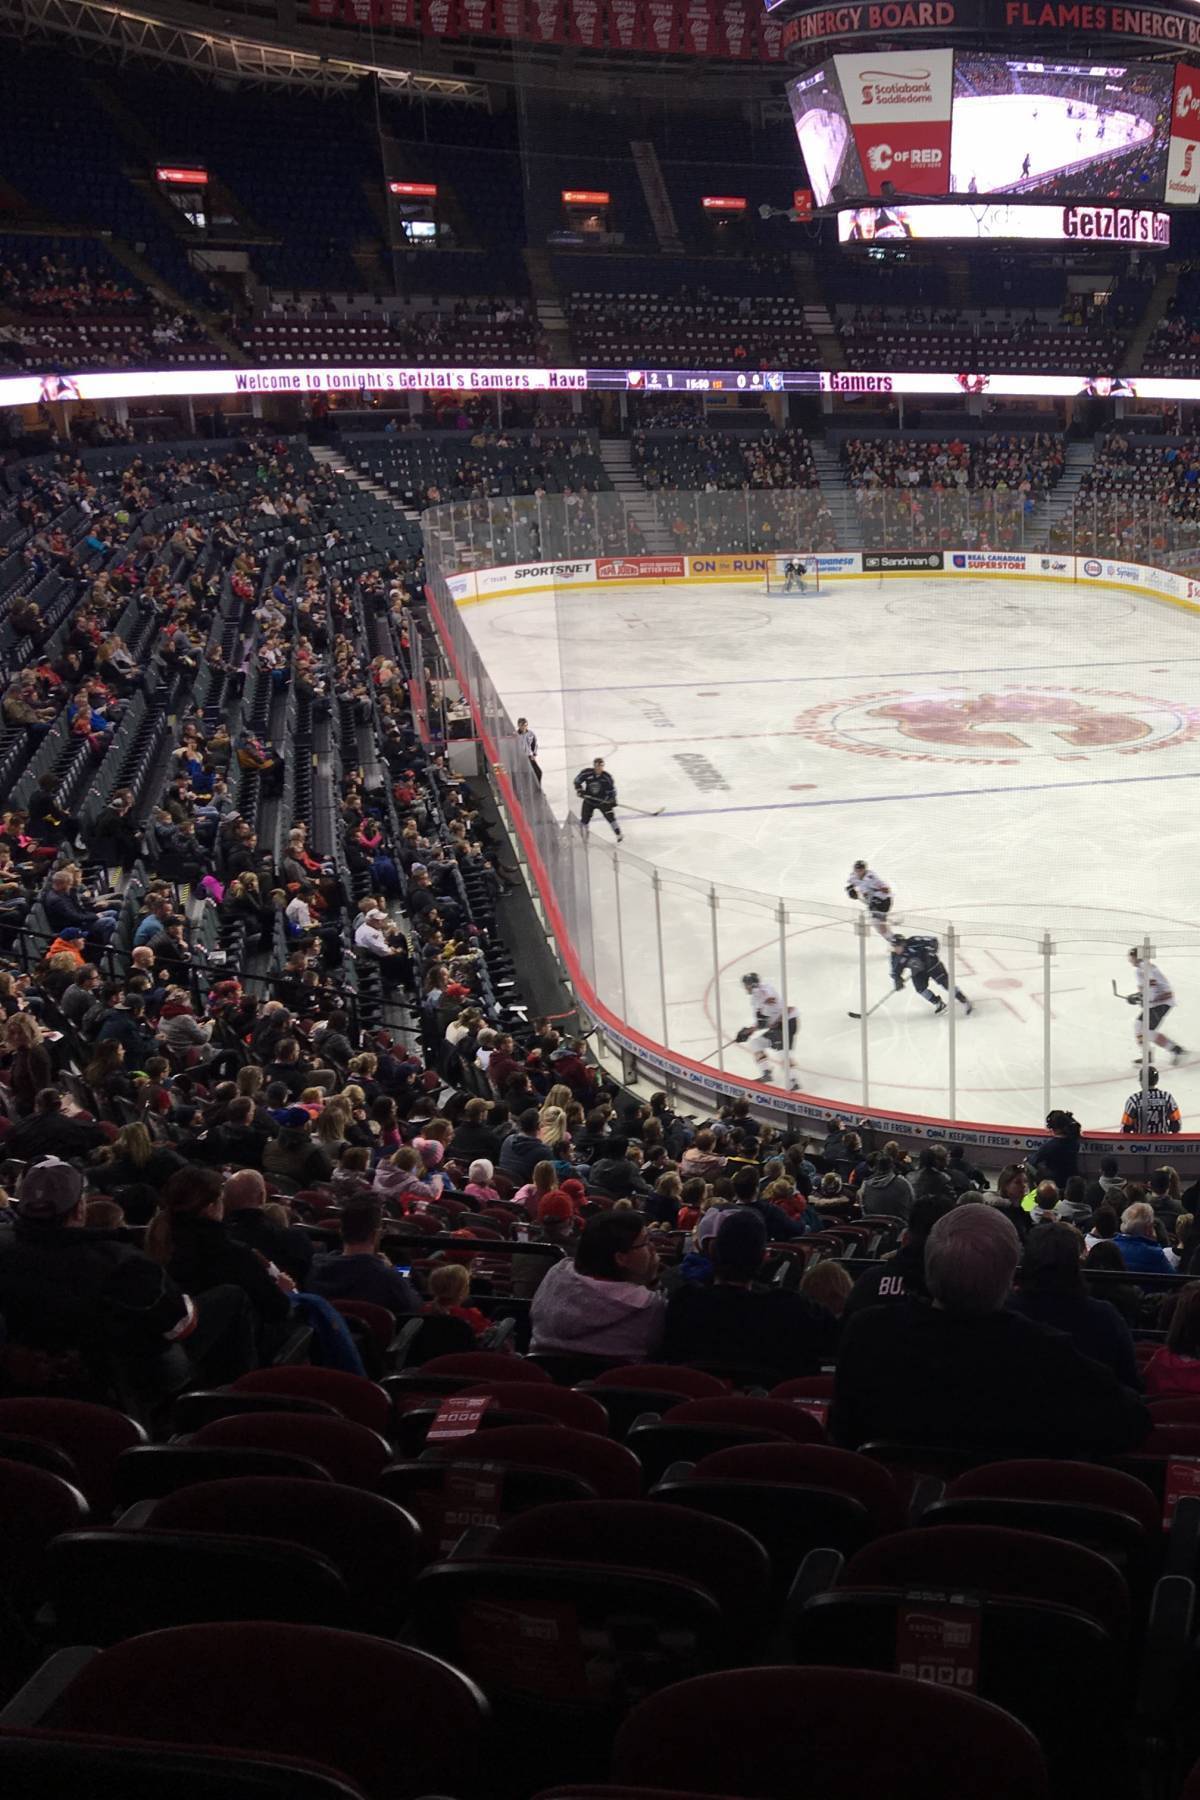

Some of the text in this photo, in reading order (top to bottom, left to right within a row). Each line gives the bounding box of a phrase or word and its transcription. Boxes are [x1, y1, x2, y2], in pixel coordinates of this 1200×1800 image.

[801, 5, 863, 38] ENERGY
[868, 2, 955, 30] BOARD
[1006, 3, 1106, 30] FLAMES
[1112, 9, 1186, 40] ENERGY
[875, 82, 931, 95] Scotiabank
[876, 94, 933, 105] Saddledome
[894, 151, 910, 162] OF
[911, 149, 943, 163] RED
[1063, 207, 1149, 240] Getzlaf's
[235, 374, 301, 390] Welcome
[306, 374, 321, 388] to
[327, 373, 394, 392] tonight's
[399, 372, 465, 387] Getzlaf's
[471, 372, 530, 387] Gamers
[550, 373, 586, 387] Have
[651, 373, 658, 384] 2
[667, 374, 673, 388] 1
[737, 374, 746, 388] 0
[830, 372, 893, 391] Gamers
[693, 560, 716, 572] ON
[733, 559, 767, 572] RUN
[881, 557, 928, 567] Sandman
[967, 554, 1026, 563] REAL CANADIAN
[515, 563, 592, 580] SPORTSNET
[967, 561, 1026, 571] SUPERSTORE
[1116, 567, 1140, 581] Synergy
[891, 1123, 913, 1135] FRESH
[949, 1131, 978, 1144] KEEPING
[979, 1134, 986, 1144] IT
[988, 1135, 1010, 1145] FRESH
[1155, 1144, 1185, 1153] KEEPING
[1186, 1144, 1193, 1152] IT
